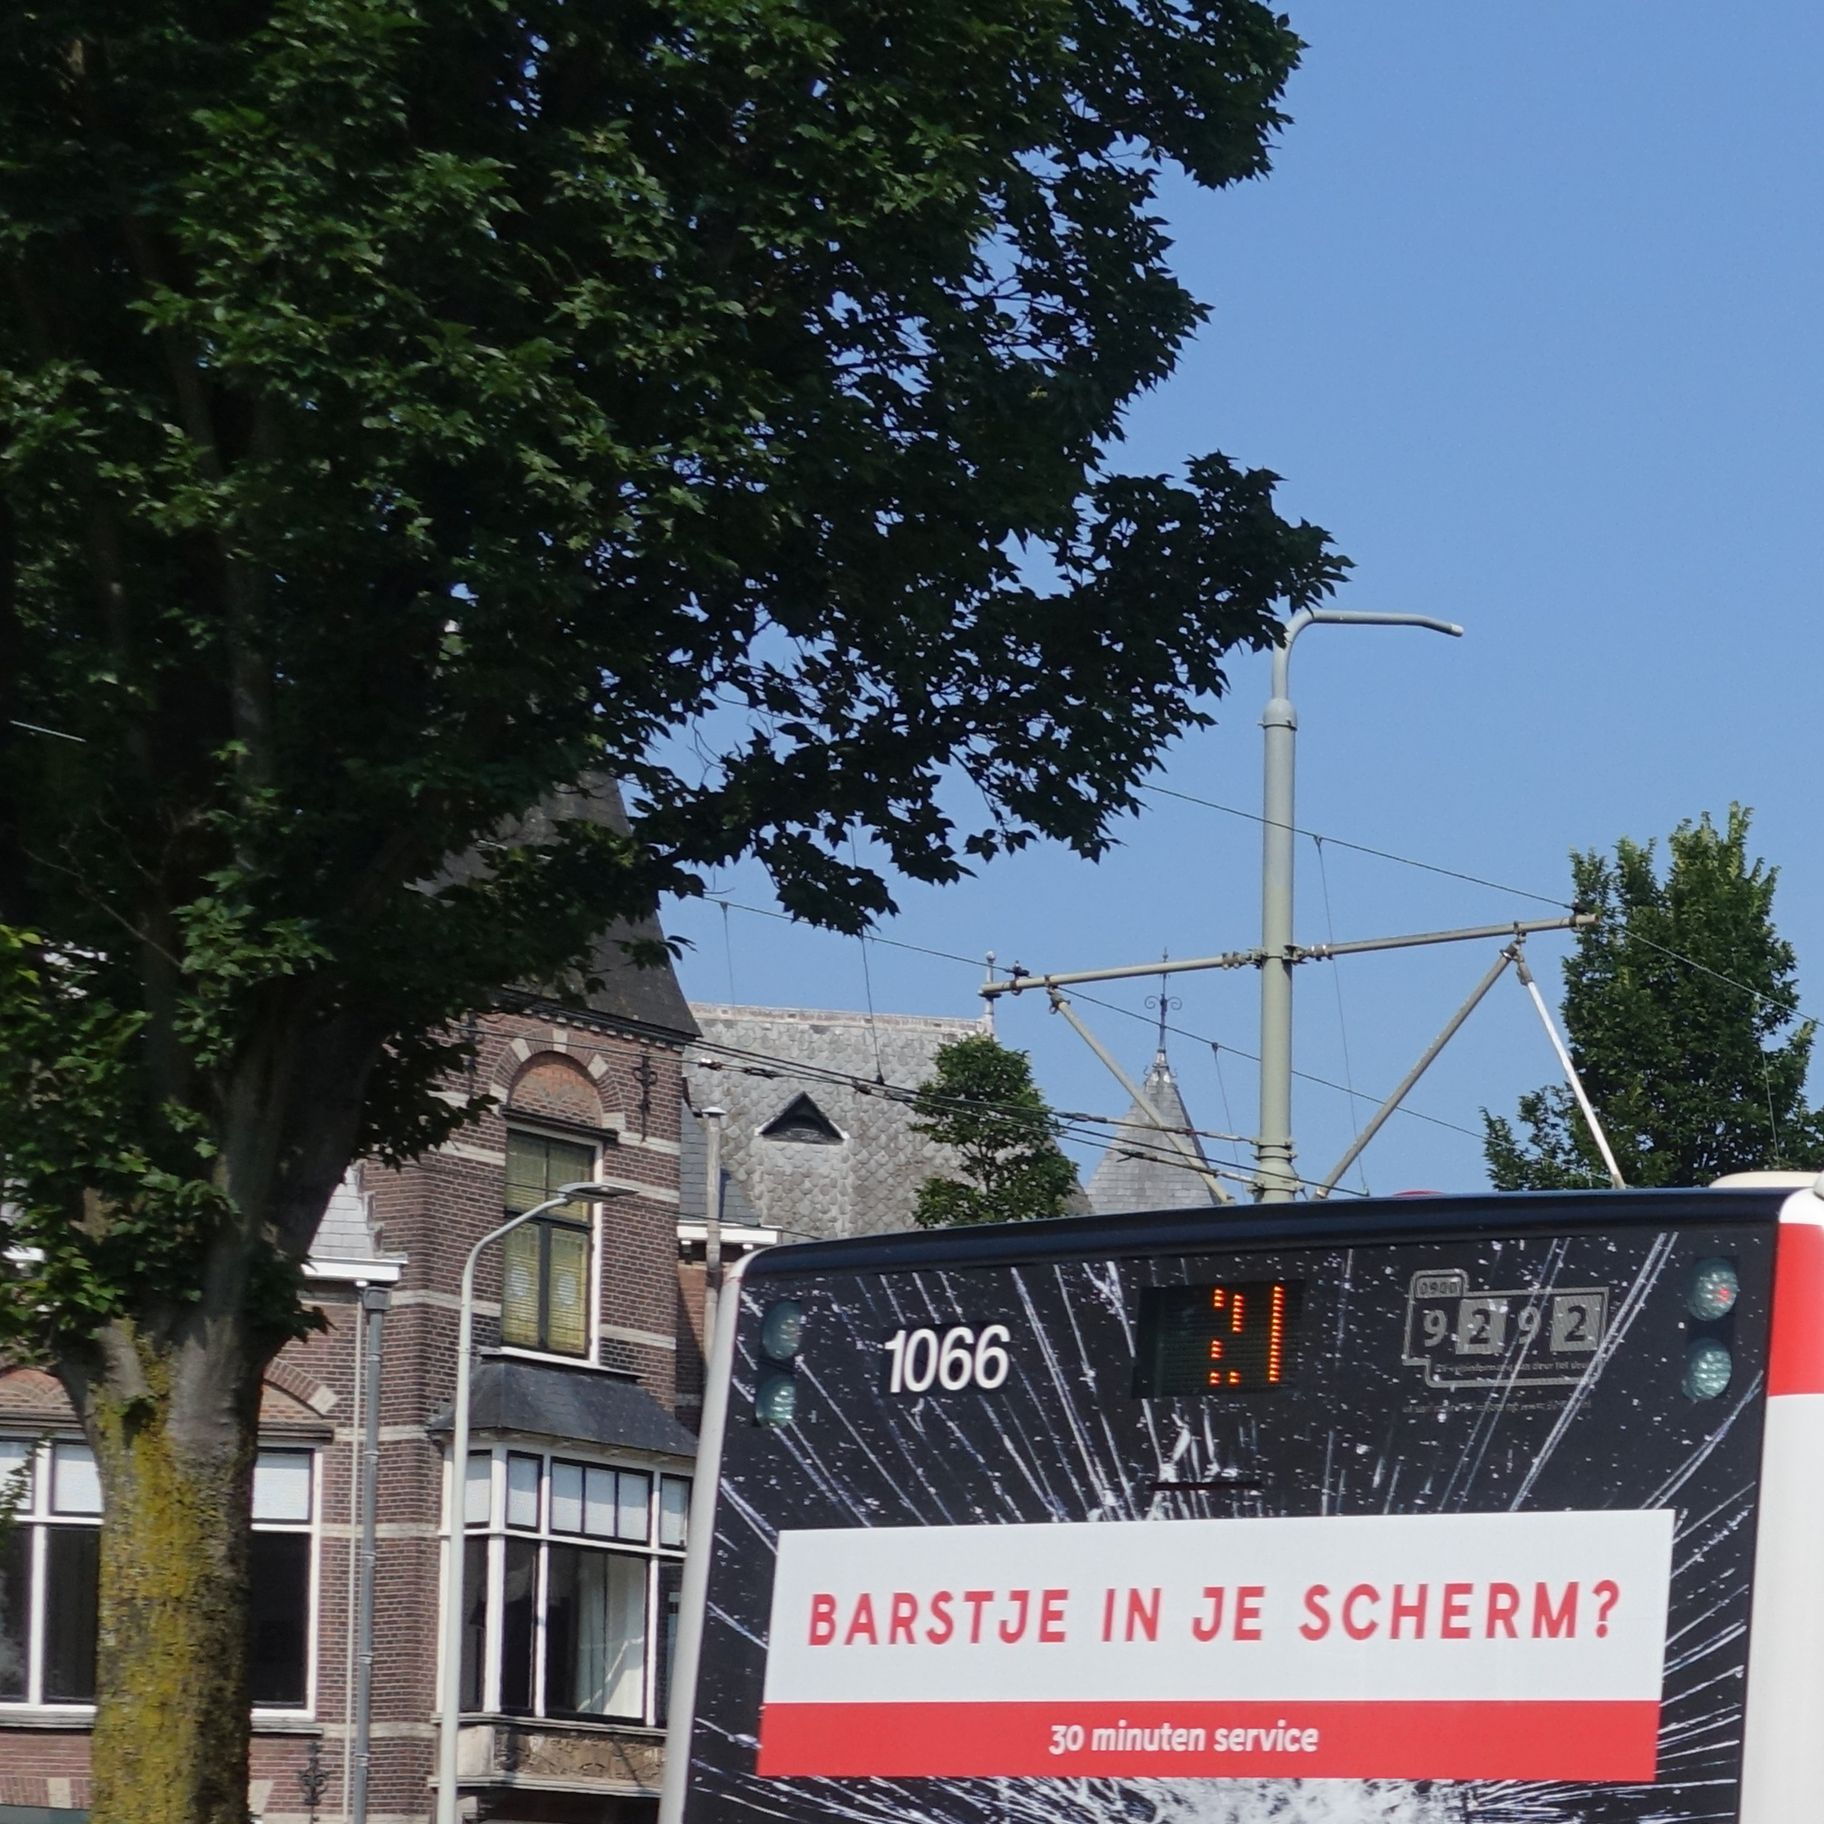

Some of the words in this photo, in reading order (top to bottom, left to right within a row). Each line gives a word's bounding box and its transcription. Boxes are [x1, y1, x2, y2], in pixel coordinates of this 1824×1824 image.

[884, 1324, 1011, 1394] 1066
[808, 1588, 1069, 1646] BARSTJE
[1101, 1586, 1162, 1643] IN
[1192, 1585, 1266, 1642] JE
[1299, 1579, 1620, 1641] SCHERM?
[1048, 1723, 1086, 1756] 30
[1091, 1718, 1206, 1753] minuten
[1214, 1719, 1320, 1753] service
